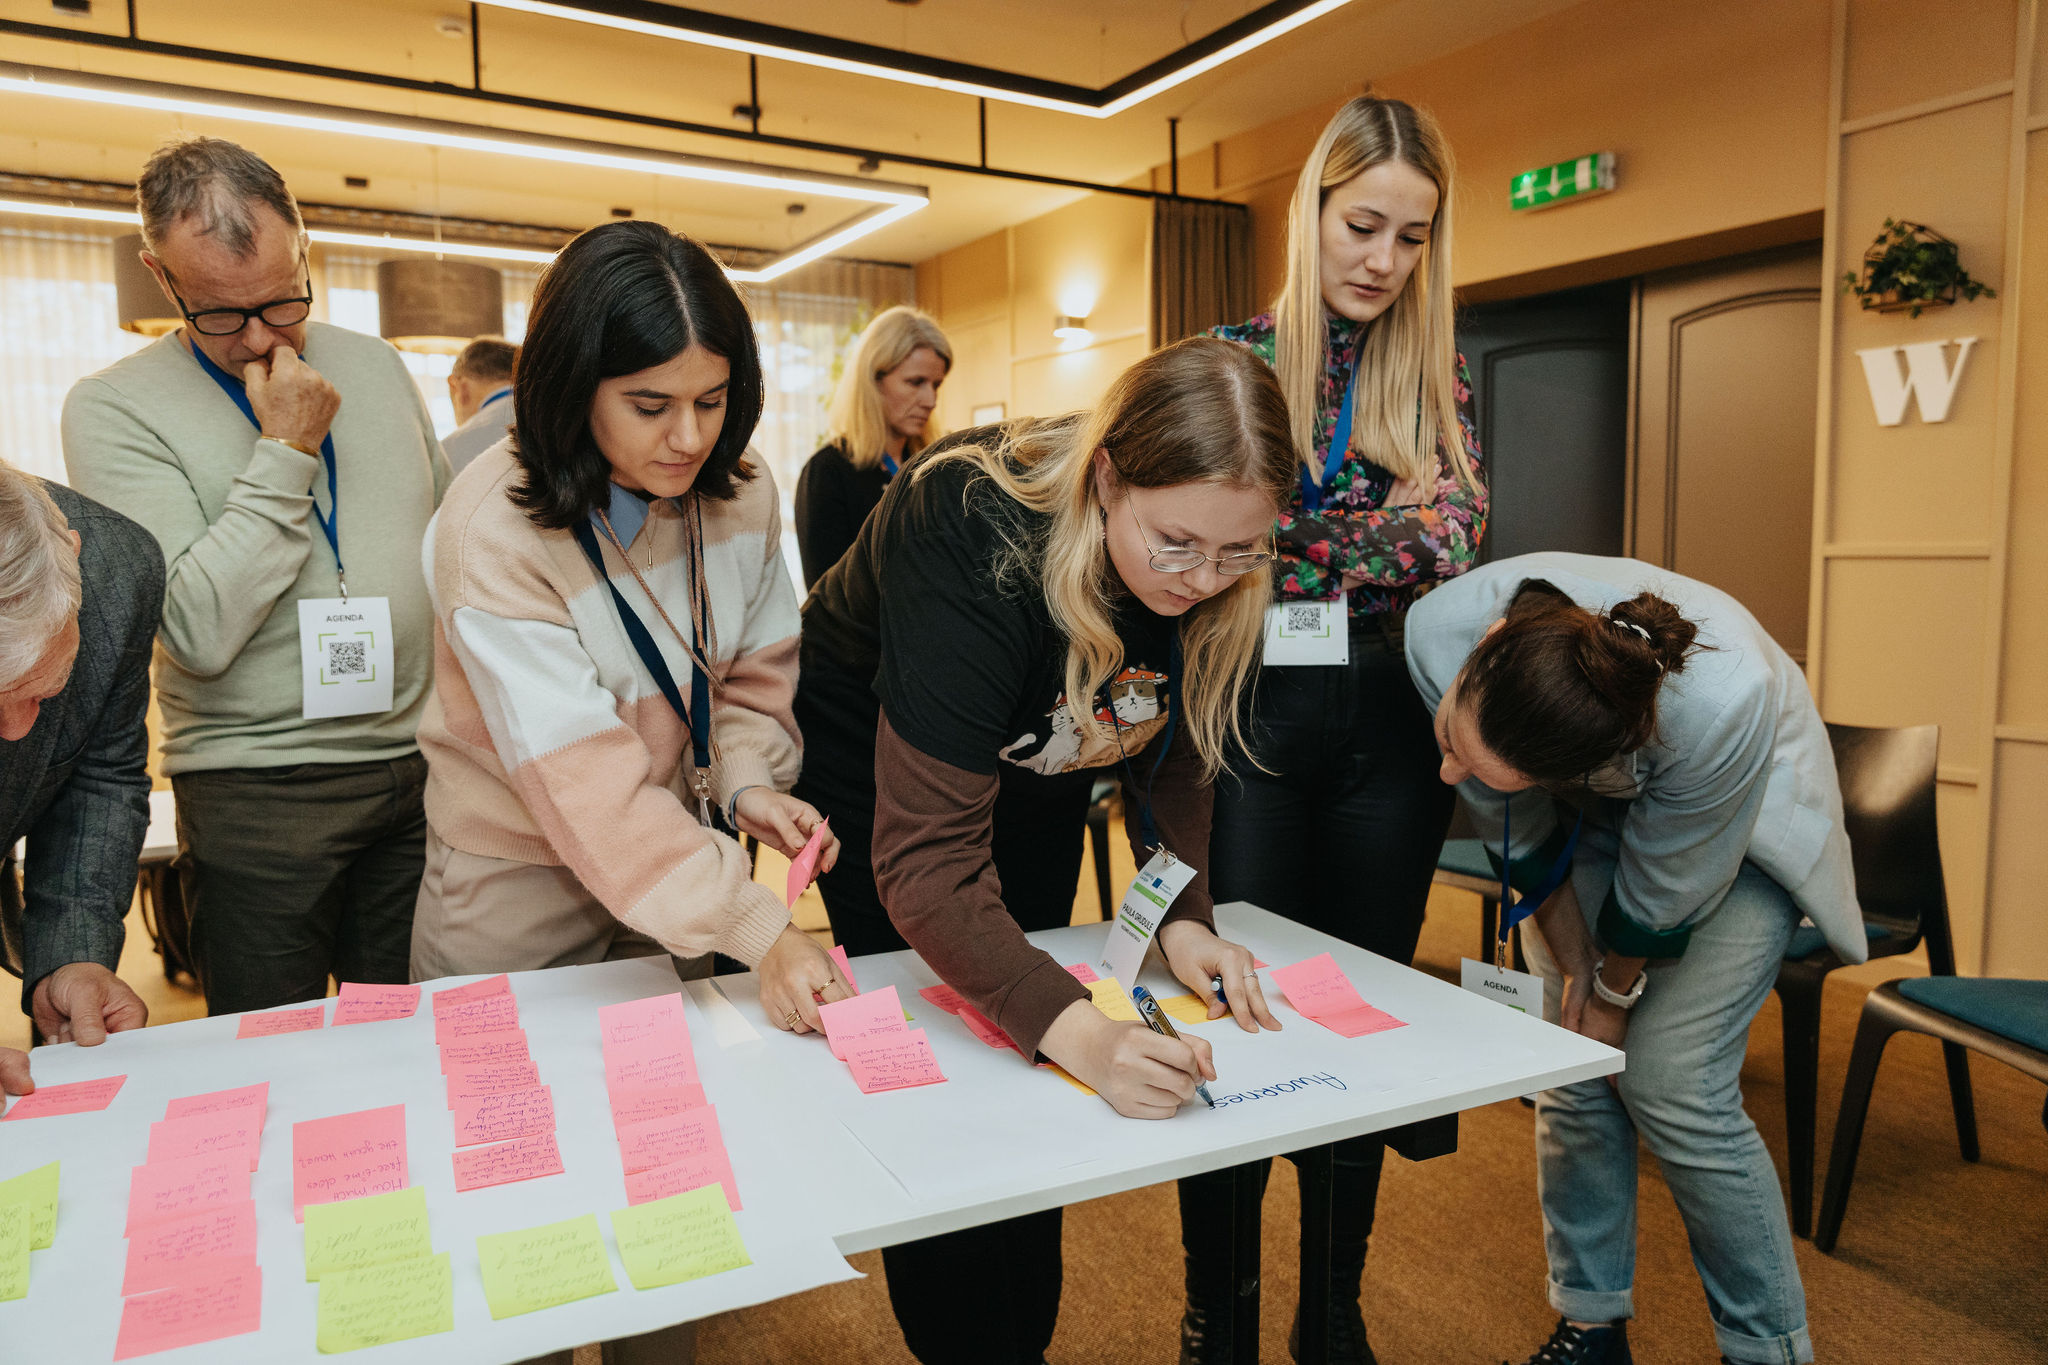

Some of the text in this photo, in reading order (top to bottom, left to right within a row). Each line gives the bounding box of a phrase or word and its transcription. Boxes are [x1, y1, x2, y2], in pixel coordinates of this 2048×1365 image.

[1855, 336, 1978, 427] W
[326, 614, 364, 623] AGENDA
[1483, 979, 1518, 995] AGENDA
[377, 1140, 399, 1152] the
